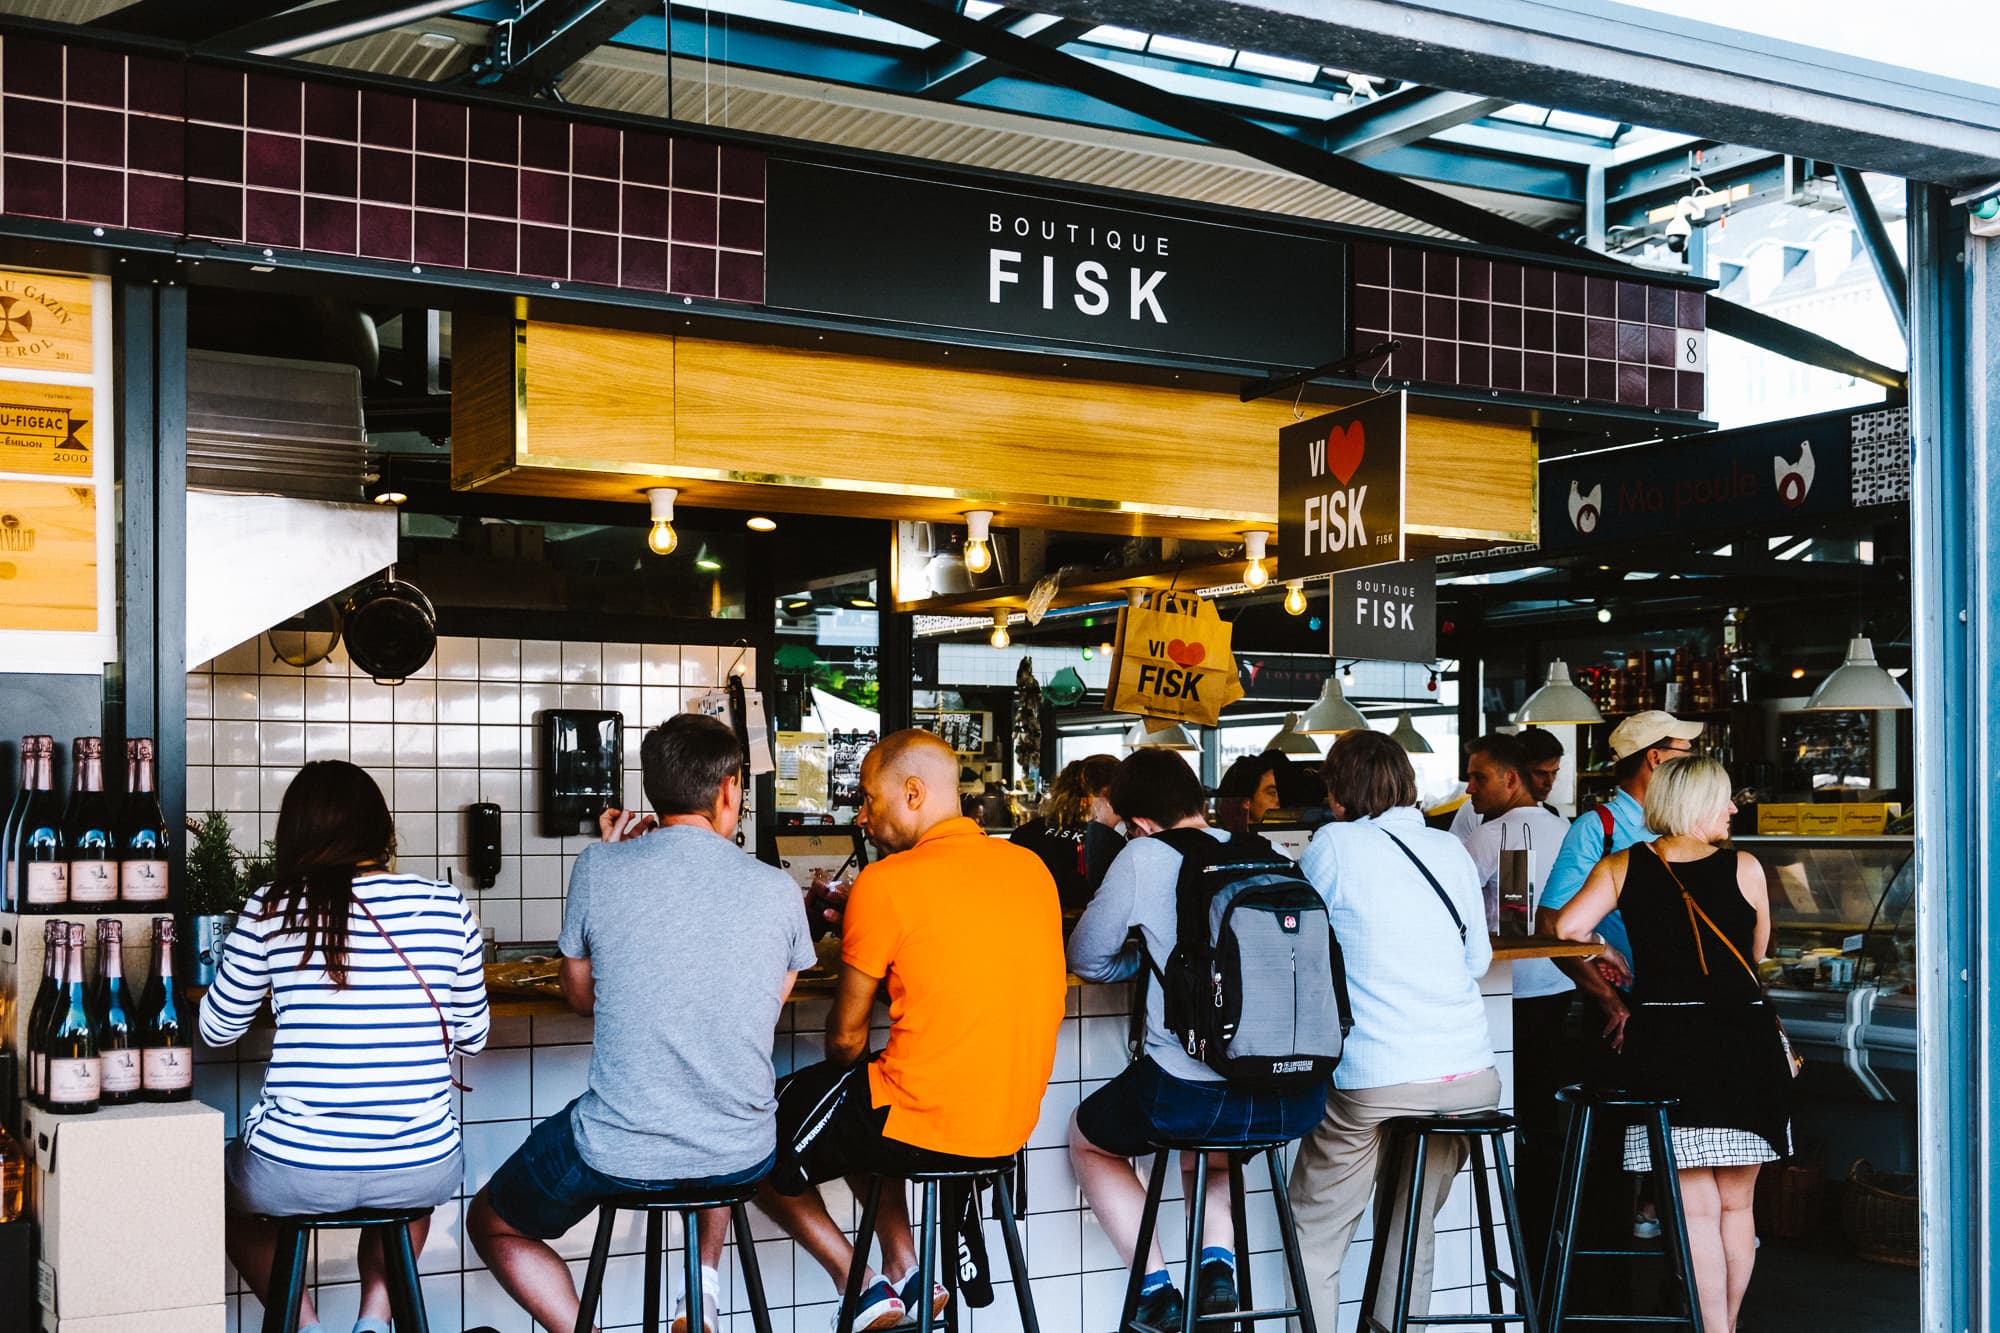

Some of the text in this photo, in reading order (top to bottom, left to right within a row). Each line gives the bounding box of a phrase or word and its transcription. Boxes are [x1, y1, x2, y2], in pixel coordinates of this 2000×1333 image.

[989, 213, 1169, 256] BOUTIQUE
[989, 248, 1168, 324] FISK
[0, 280, 73, 325] U GAZIN
[1686, 337, 1698, 364] 8
[53, 452, 88, 464] 2000
[1309, 439, 1326, 478] VI
[1618, 457, 1759, 519] Ma poule
[1304, 485, 1368, 557] FISK
[1376, 533, 1393, 546] FISK
[1356, 580, 1416, 598] BOUTIQUE
[1356, 597, 1415, 631] FISK
[1148, 639, 1166, 659] VI
[1137, 663, 1204, 702] FISK
[1044, 828, 1084, 843] FISK
[212, 922, 234, 936] BE
[1272, 1062, 1284, 1074] 13
